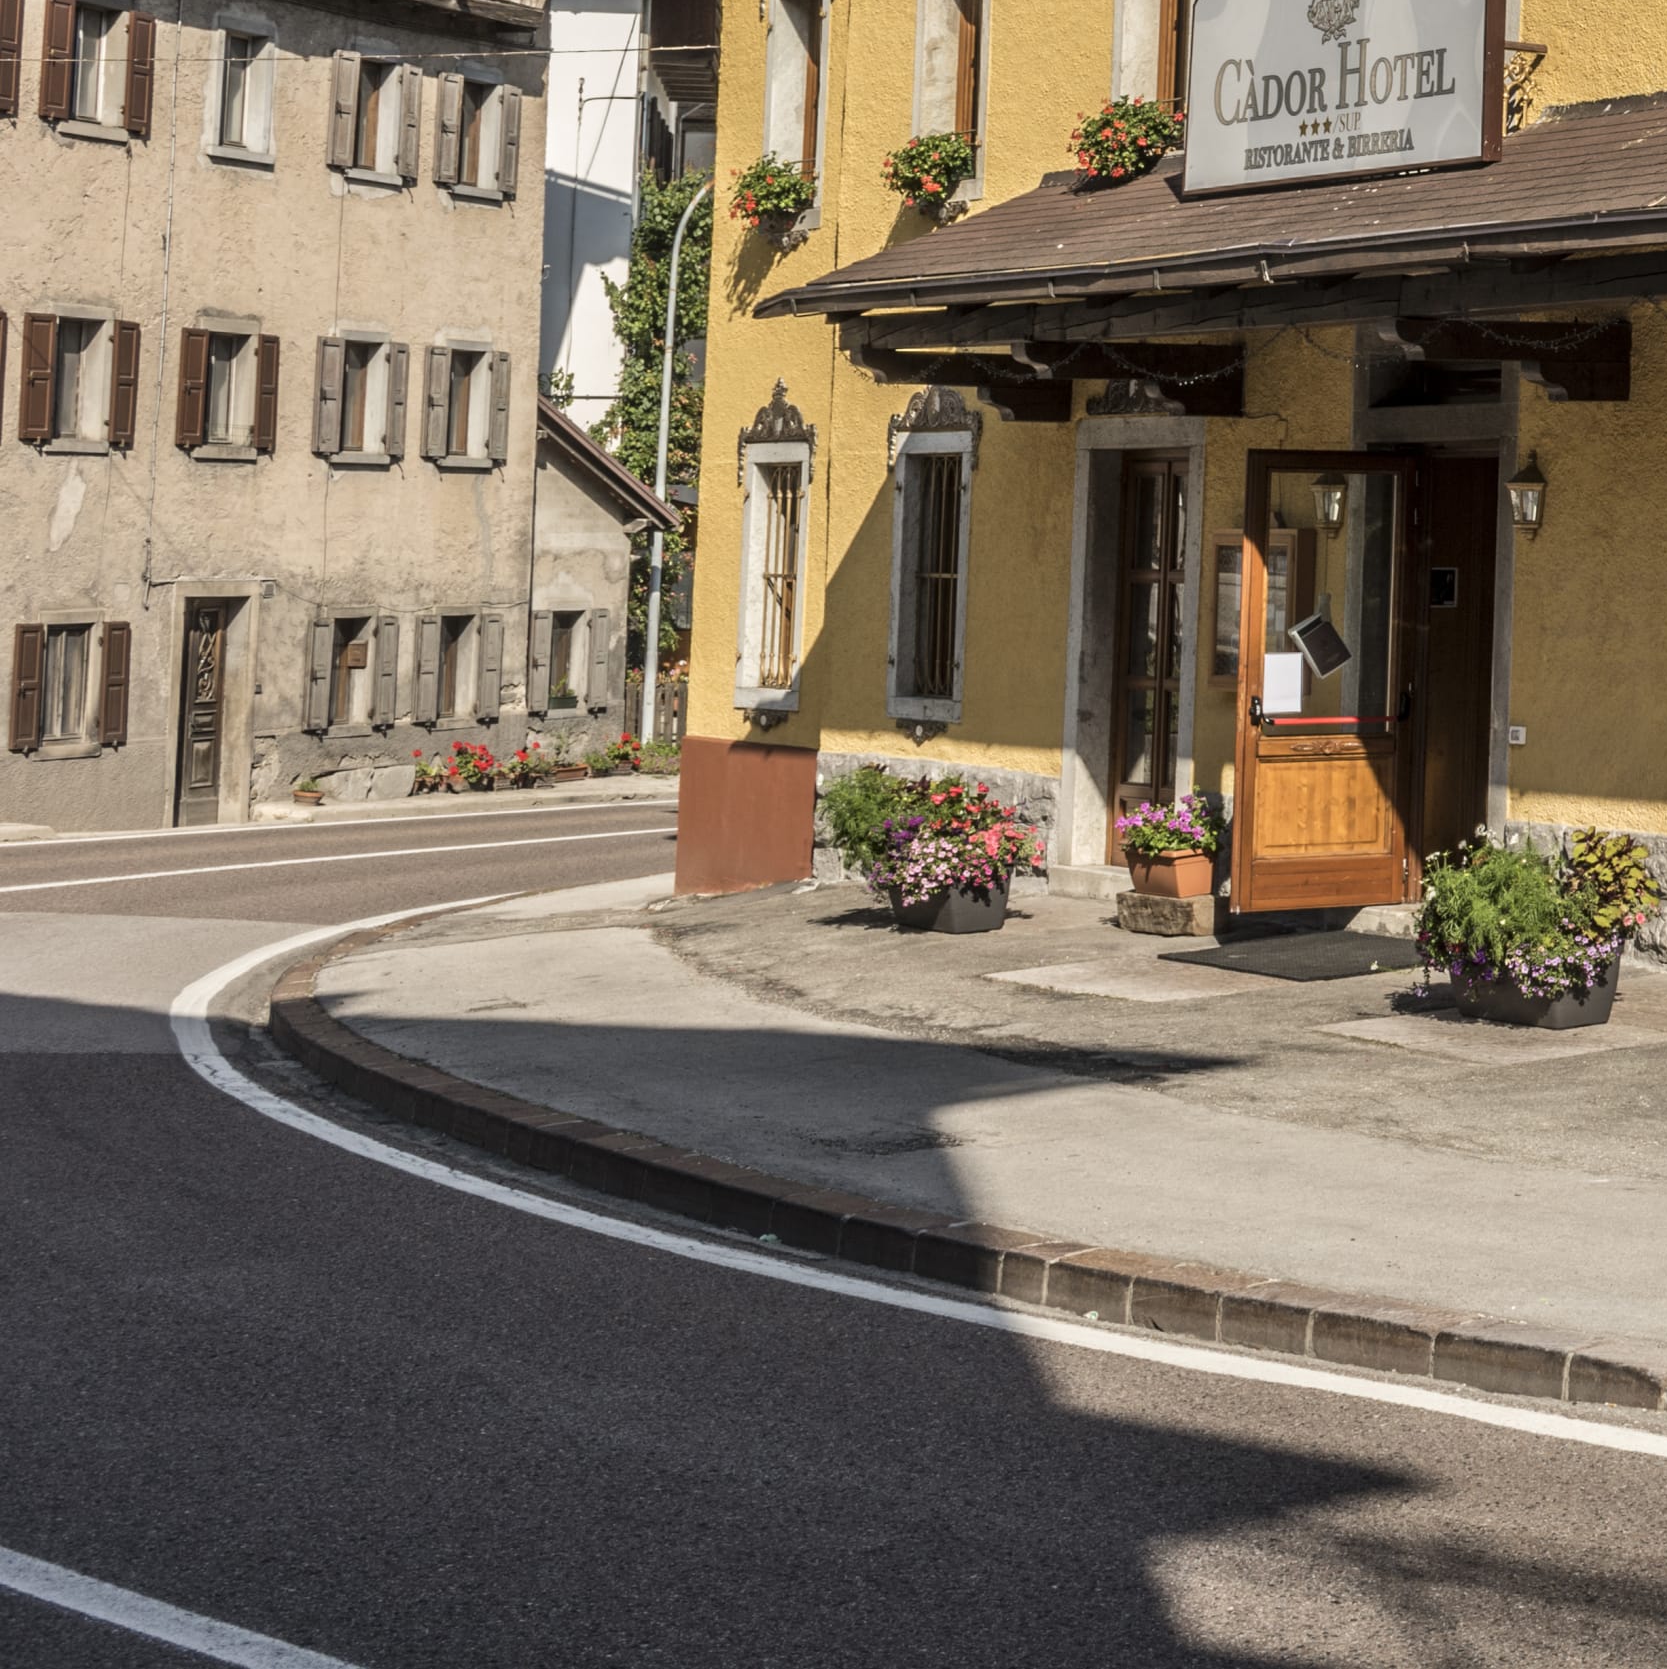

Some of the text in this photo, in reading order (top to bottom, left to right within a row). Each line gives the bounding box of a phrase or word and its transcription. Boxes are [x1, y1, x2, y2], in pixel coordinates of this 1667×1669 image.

[1335, 38, 1456, 110] HOTEL
[1244, 127, 1415, 170] RISTORANTE & BIRRERIA
